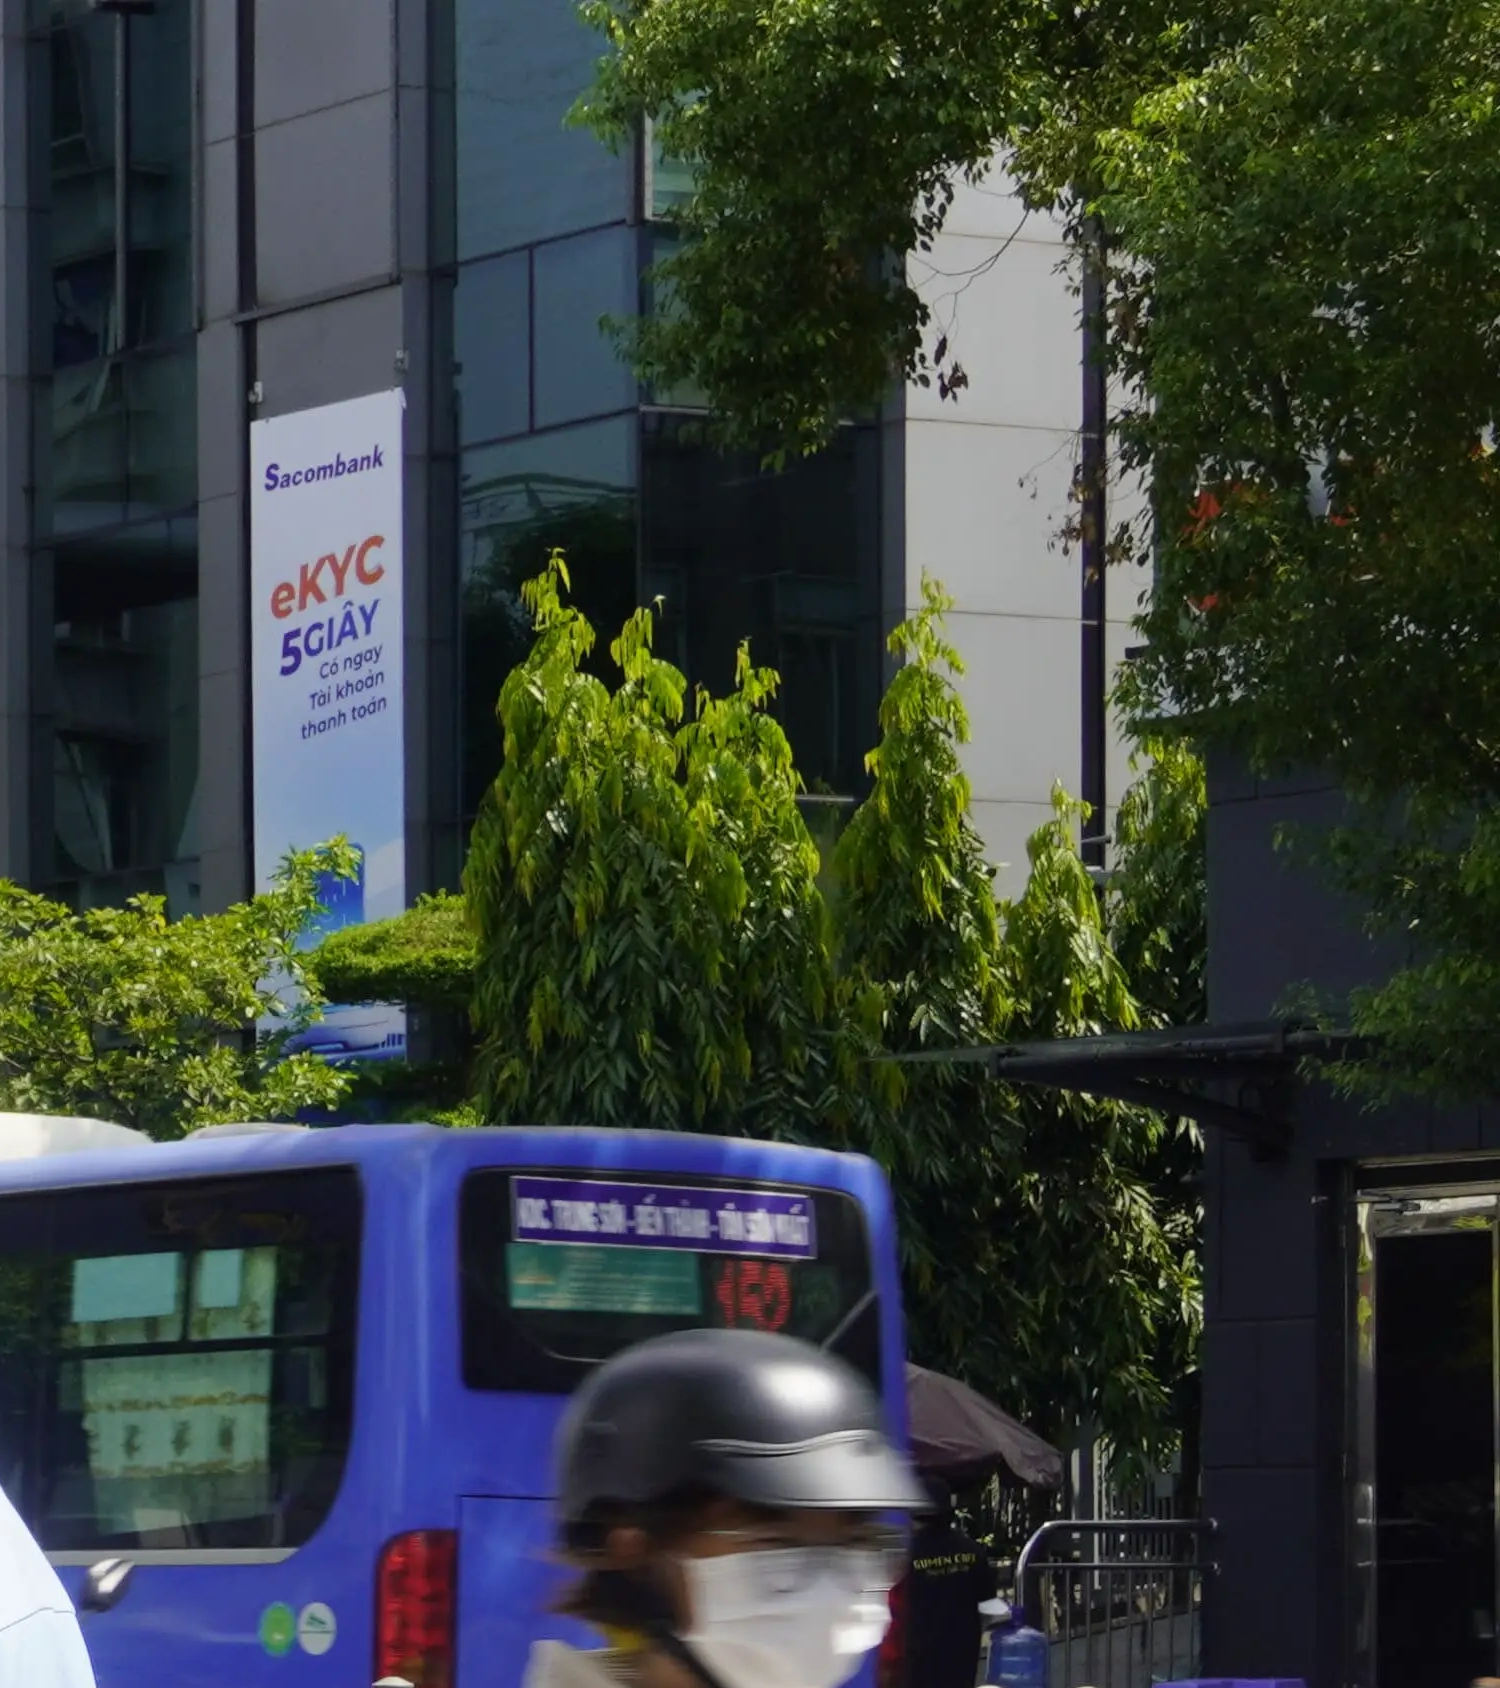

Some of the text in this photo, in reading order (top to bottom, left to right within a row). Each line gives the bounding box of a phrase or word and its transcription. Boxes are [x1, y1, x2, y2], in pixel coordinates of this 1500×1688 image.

[264, 443, 384, 491] Sacombank
[271, 535, 385, 619] eKYC
[319, 643, 383, 679] Có ngay
[309, 669, 385, 710] Tài khoản
[301, 695, 387, 740] thanh toán
